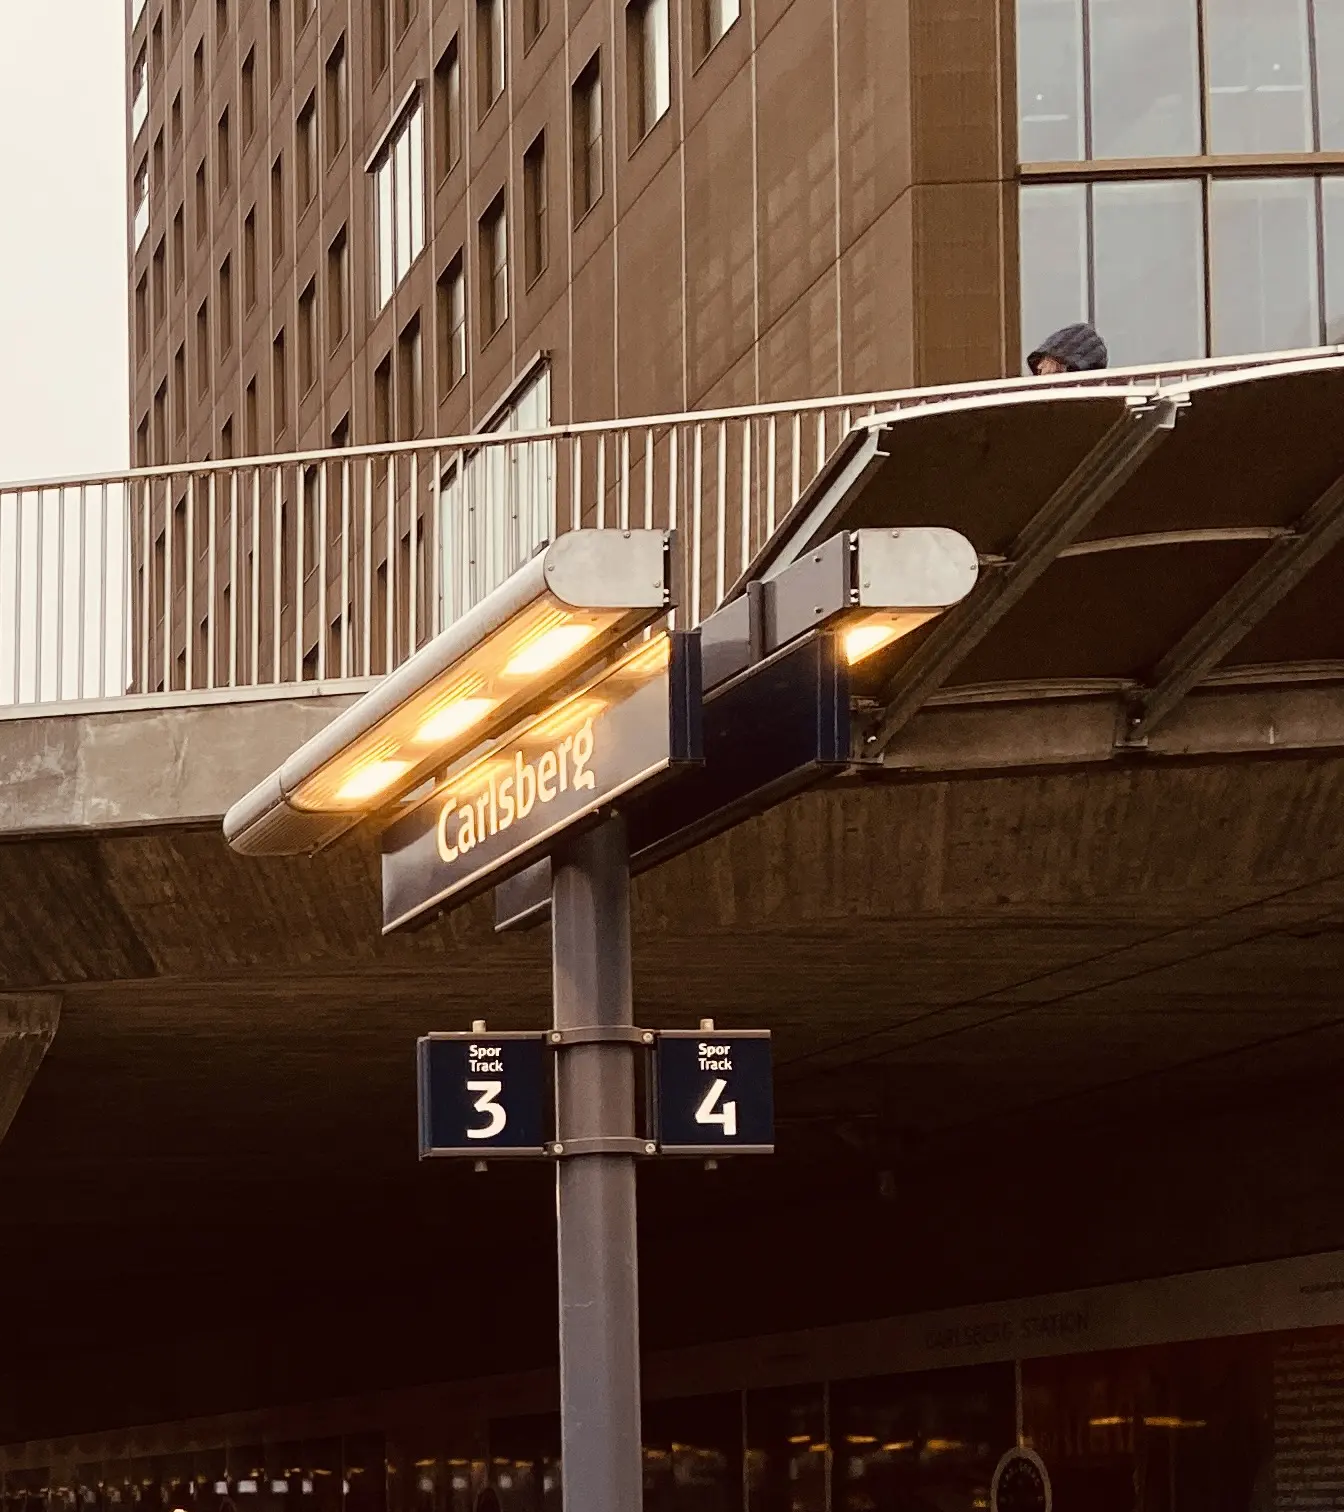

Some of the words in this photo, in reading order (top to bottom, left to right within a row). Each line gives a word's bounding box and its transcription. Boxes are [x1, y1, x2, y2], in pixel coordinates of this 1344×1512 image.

[437, 716, 597, 863] Carlsberg
[468, 1044, 502, 1058] Spor
[698, 1043, 731, 1057] Spor
[468, 1059, 504, 1072] Track
[698, 1058, 733, 1071] Track
[466, 1080, 507, 1139] 3
[694, 1078, 737, 1136] 4
